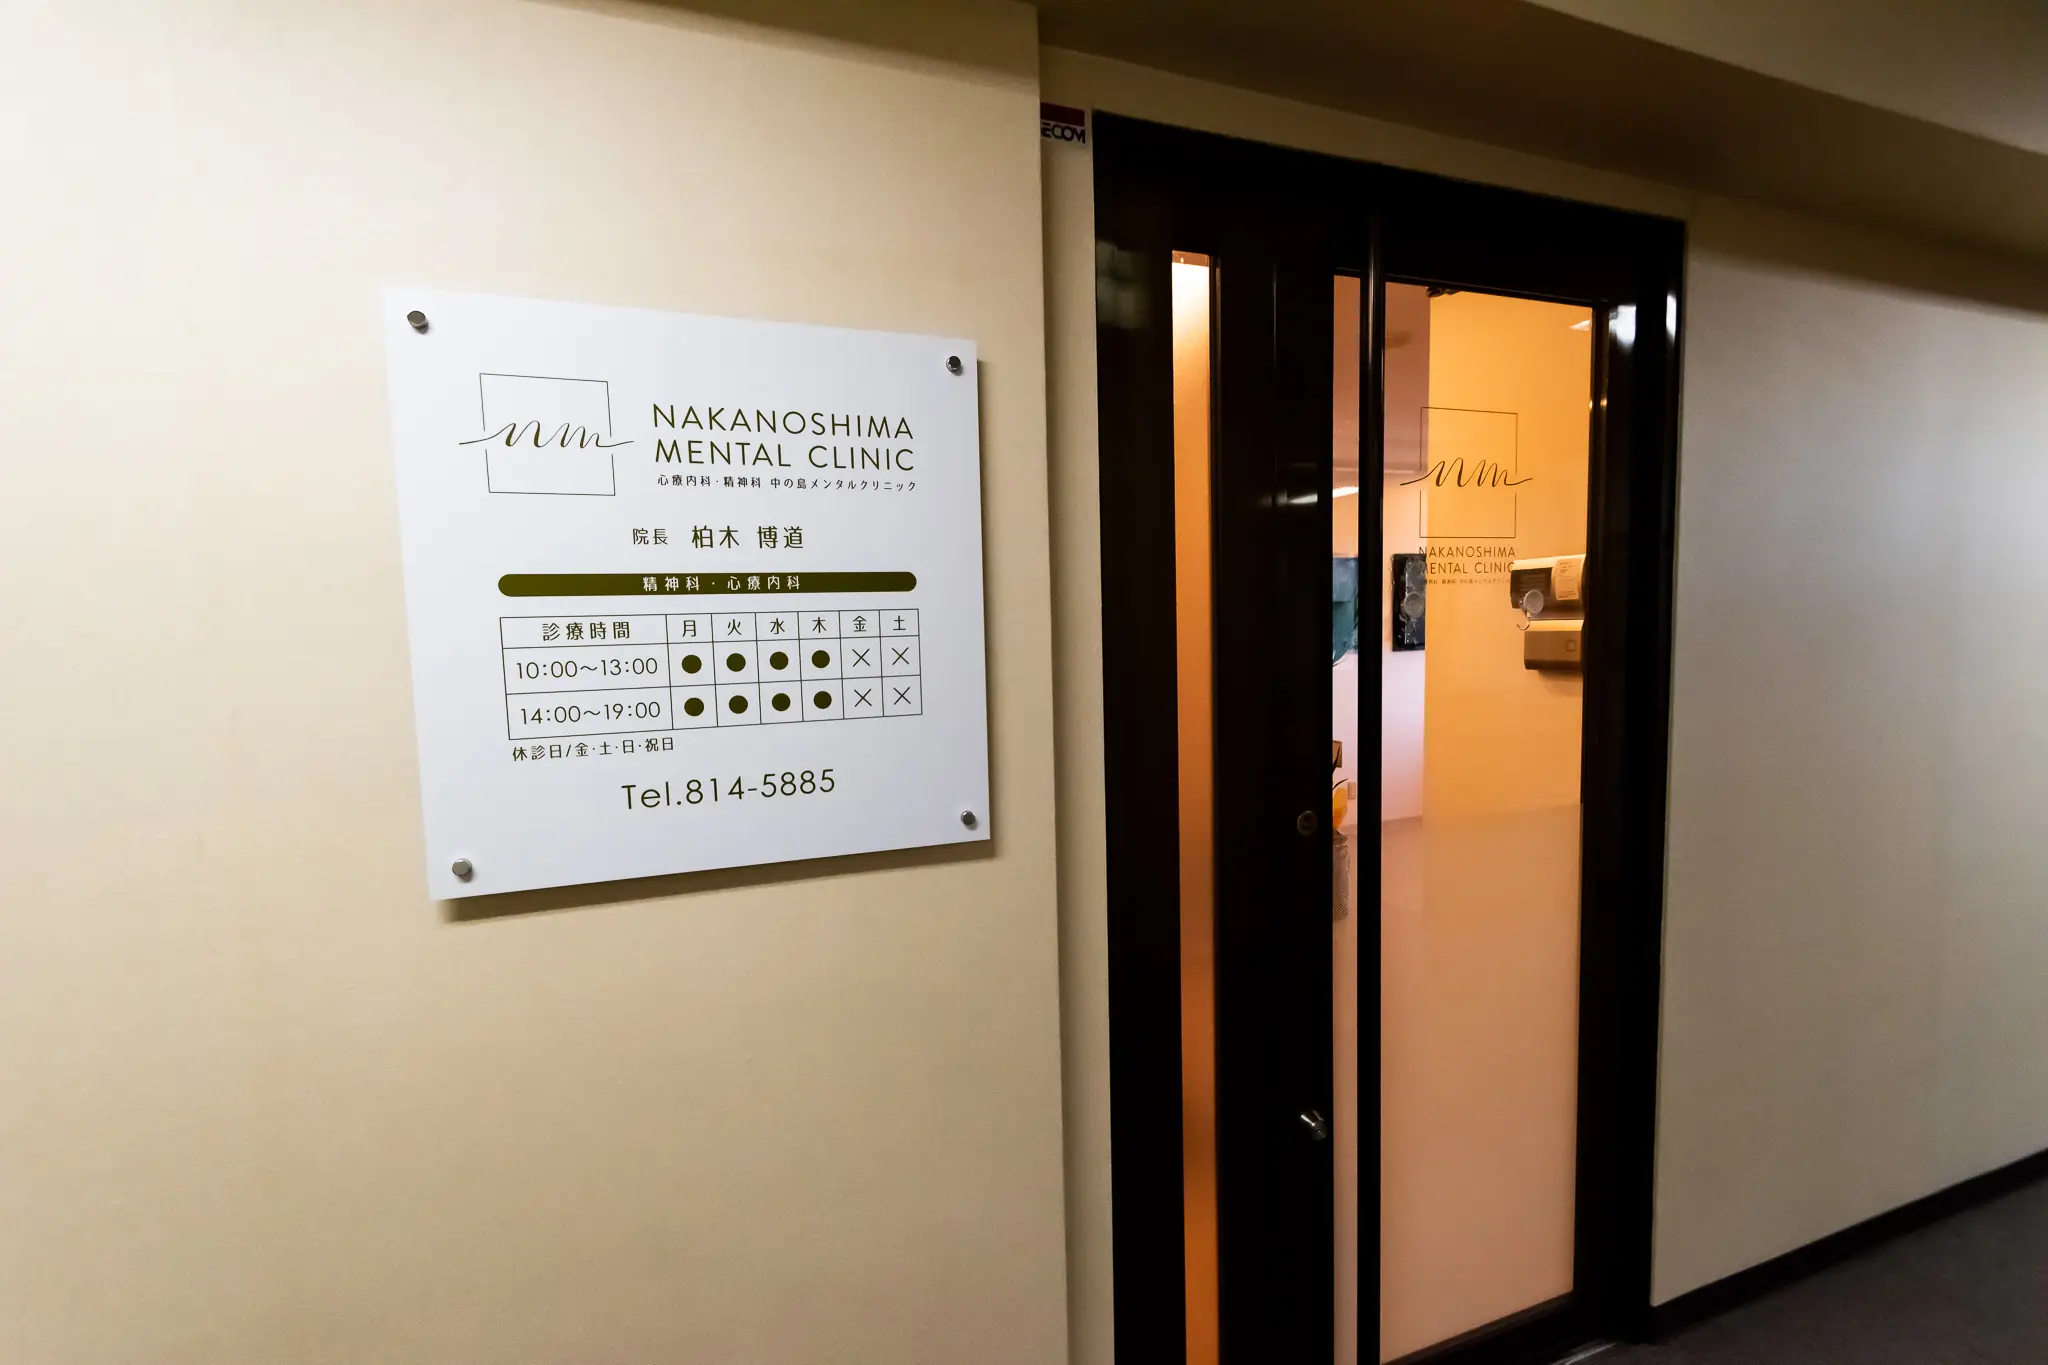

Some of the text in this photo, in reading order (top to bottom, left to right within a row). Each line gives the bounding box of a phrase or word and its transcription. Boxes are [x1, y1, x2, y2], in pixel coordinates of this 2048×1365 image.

[1041, 121, 1086, 144] ECOM
[653, 403, 914, 440] NAKANOSHIMA
[655, 438, 915, 472] MENTAL CLINIC
[770, 477, 917, 493] 中の島メンタルクリニック
[632, 524, 804, 549] 院長 柏木 博道
[1419, 546, 1516, 558] NAKANOSHIMA
[542, 615, 907, 641] 診療時間 月 火 水 木 金 土
[621, 768, 836, 809] Tel.814-5885
